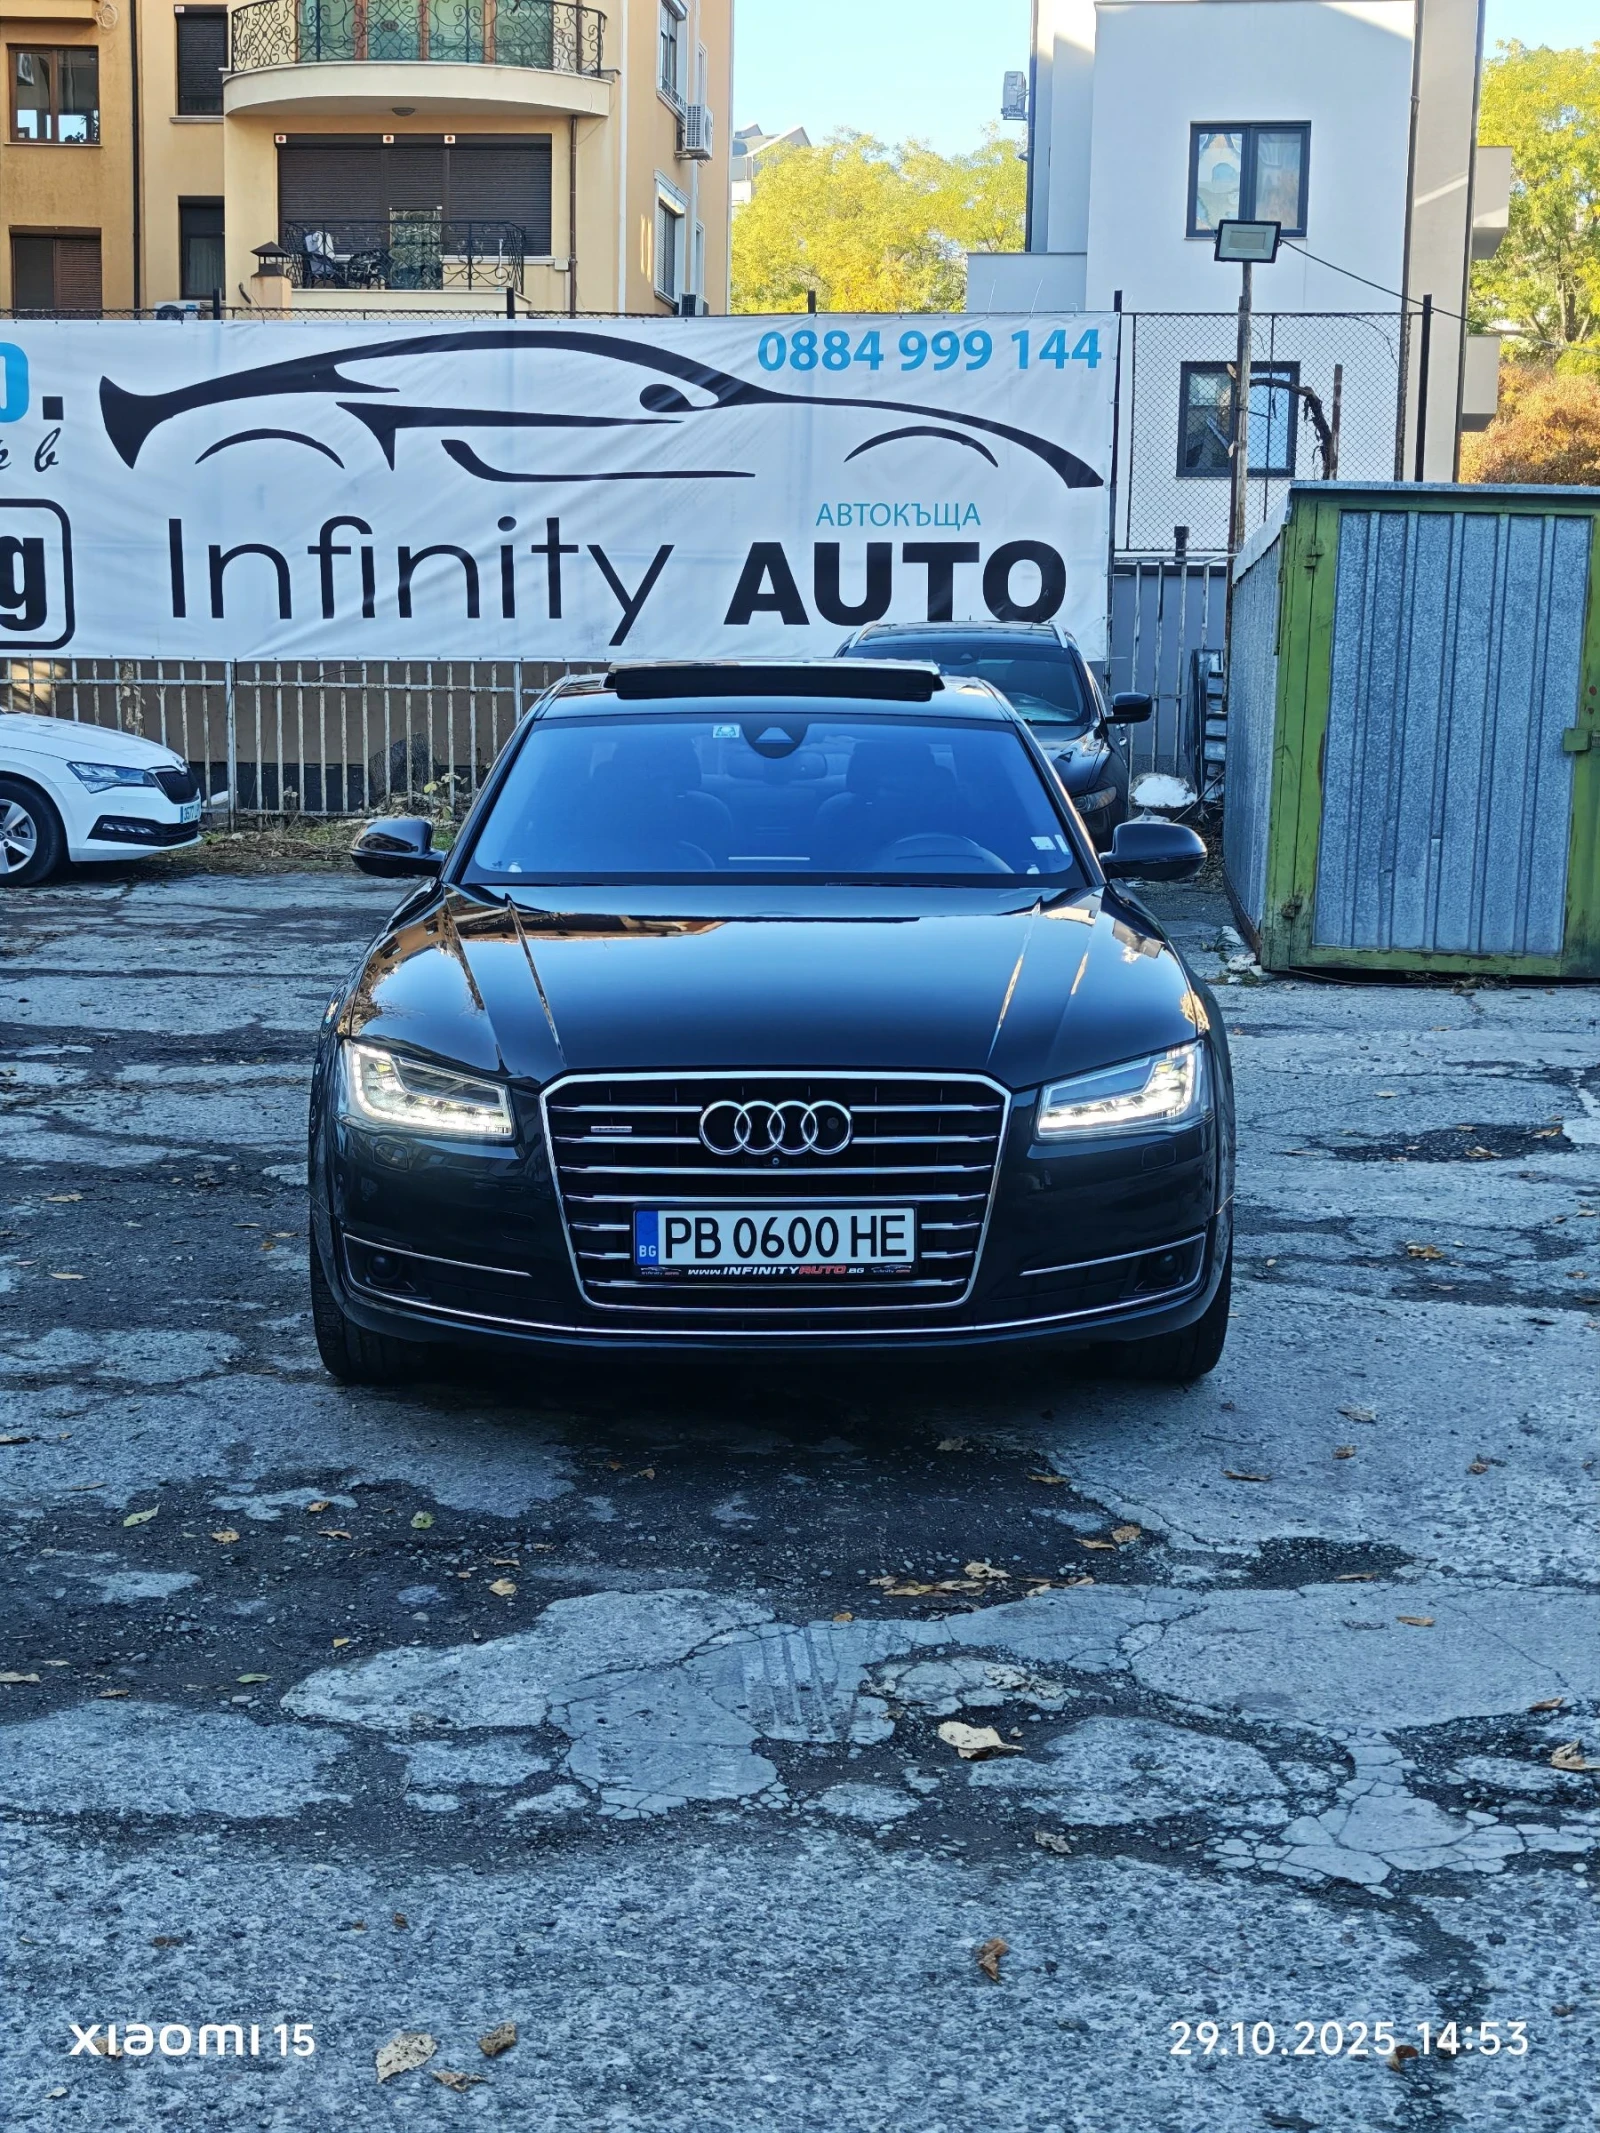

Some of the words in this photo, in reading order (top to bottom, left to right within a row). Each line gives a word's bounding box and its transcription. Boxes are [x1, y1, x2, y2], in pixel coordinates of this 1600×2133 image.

[757, 329, 884, 372] 0884
[899, 329, 993, 372] 999
[1011, 328, 1102, 370] 144
[815, 502, 981, 532] АВТОКЪЩА
[168, 515, 675, 647] Infinity
[723, 539, 1067, 626] AUTO
[638, 1245, 657, 1259] BG
[665, 1216, 722, 1259] PB
[733, 1215, 839, 1258] 0600
[851, 1214, 907, 1258] HE
